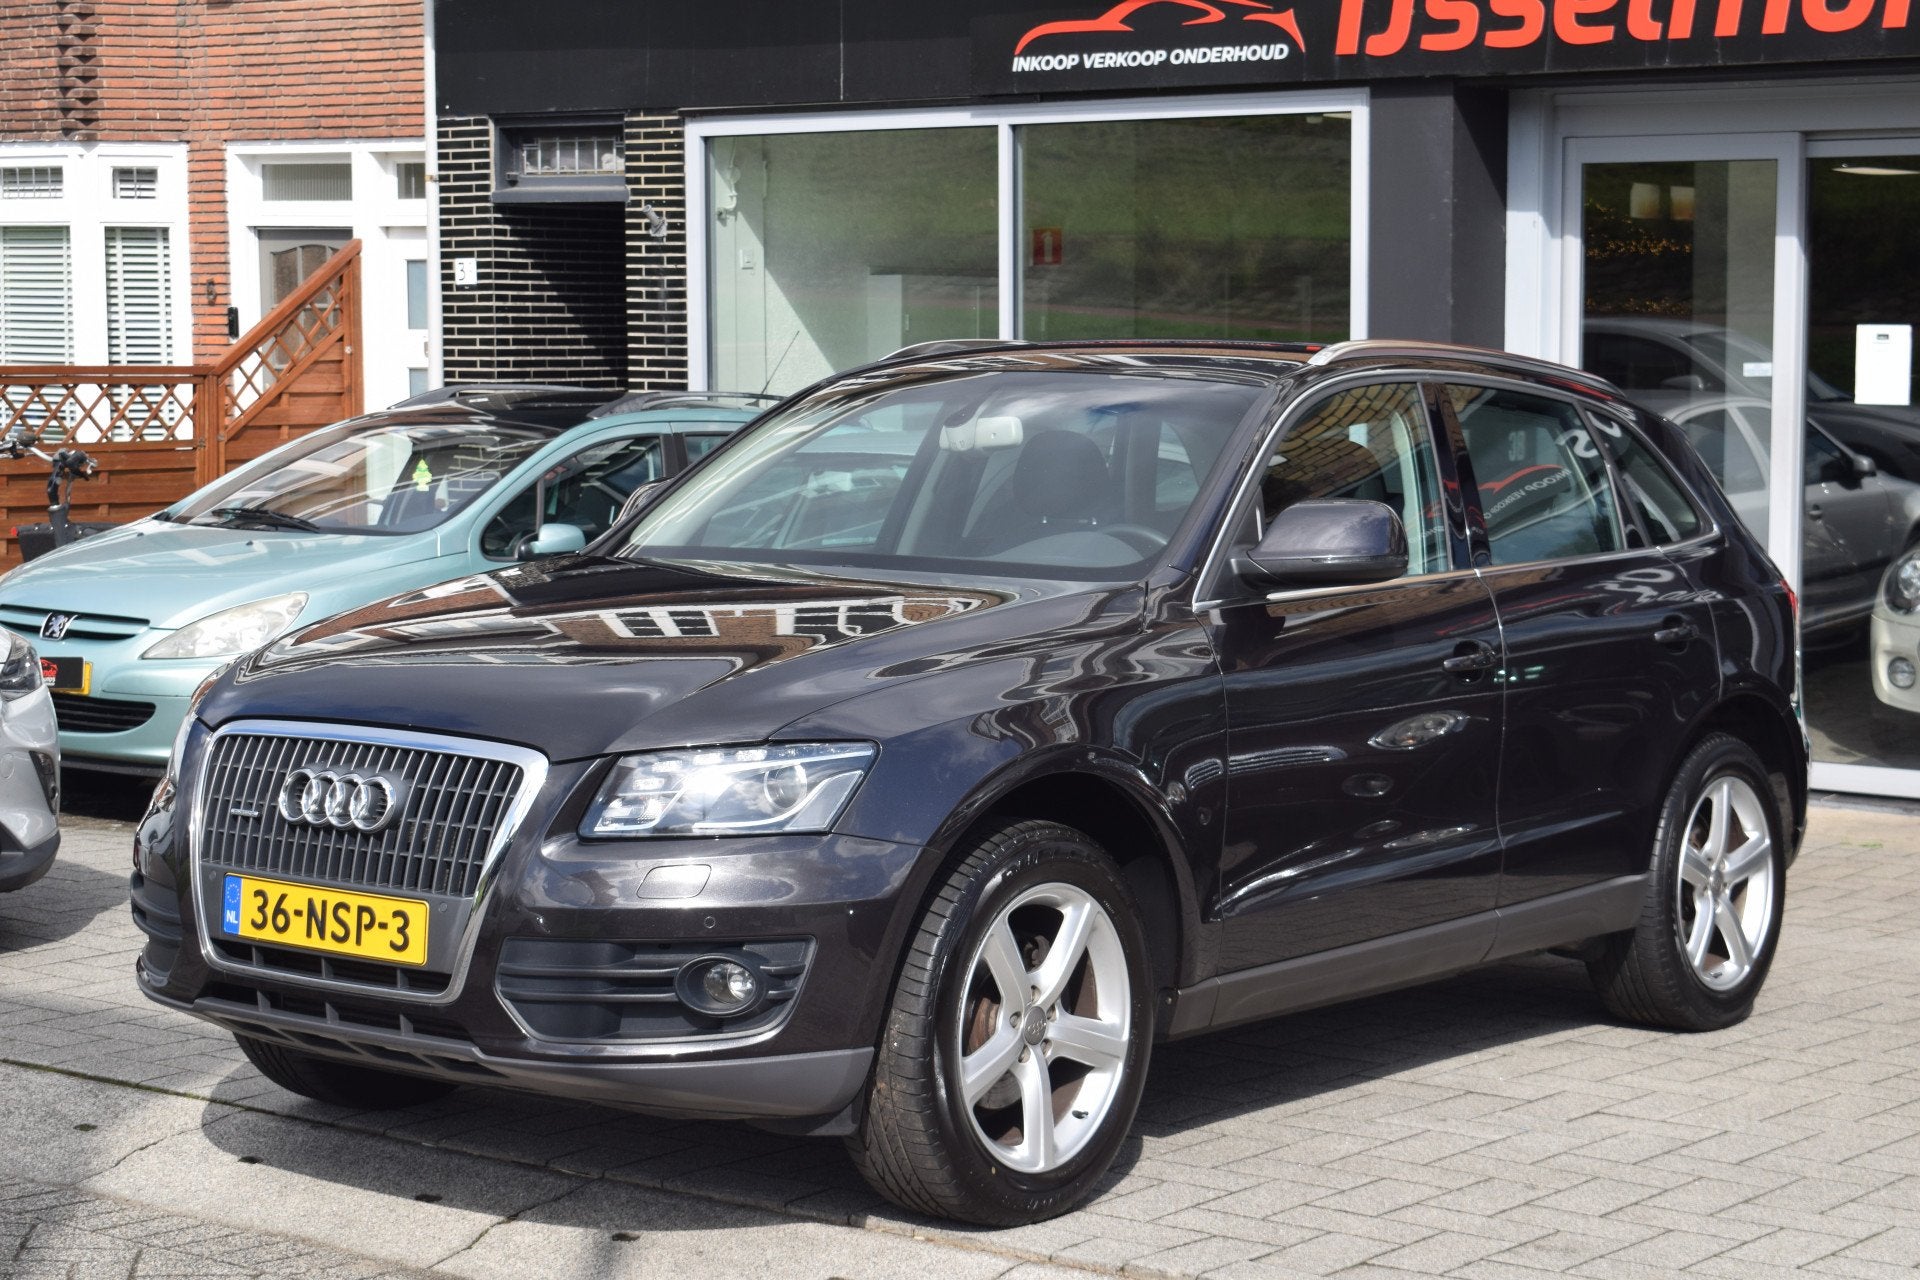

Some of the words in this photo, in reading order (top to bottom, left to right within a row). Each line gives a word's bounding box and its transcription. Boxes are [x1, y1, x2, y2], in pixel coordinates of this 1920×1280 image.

[1012, 54, 1080, 72] INKOOP
[1082, 49, 1167, 69] VERKOOP
[1170, 43, 1290, 65] ONDERHOUD
[226, 910, 238, 924] NL
[250, 889, 410, 952] 36-NSP-3
